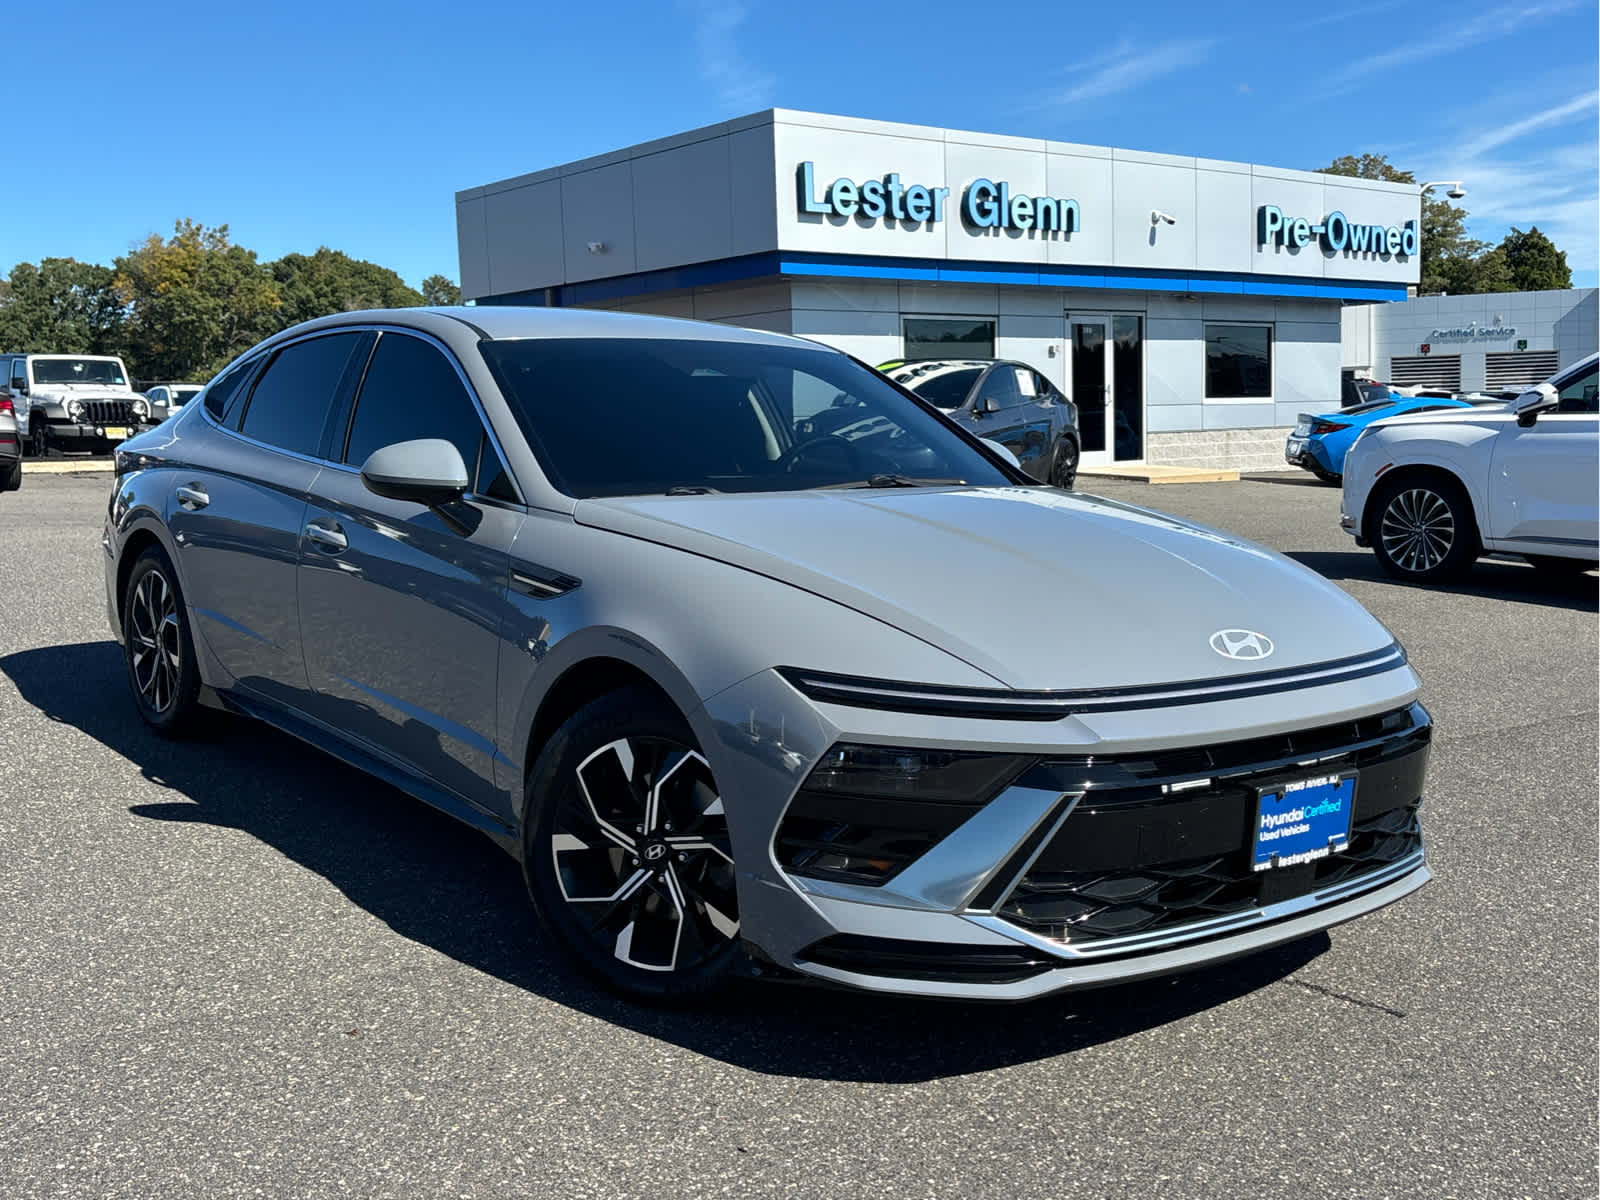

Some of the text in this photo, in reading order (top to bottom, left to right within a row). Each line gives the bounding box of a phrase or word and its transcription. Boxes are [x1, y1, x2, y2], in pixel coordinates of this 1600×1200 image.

[796, 160, 1080, 232] Lester Glenn
[1257, 205, 1417, 256] Pre-Owned
[1432, 327, 1515, 338] Certified Service
[1285, 781, 1305, 793] TOMS
[1259, 824, 1310, 842] Used Vehicles
